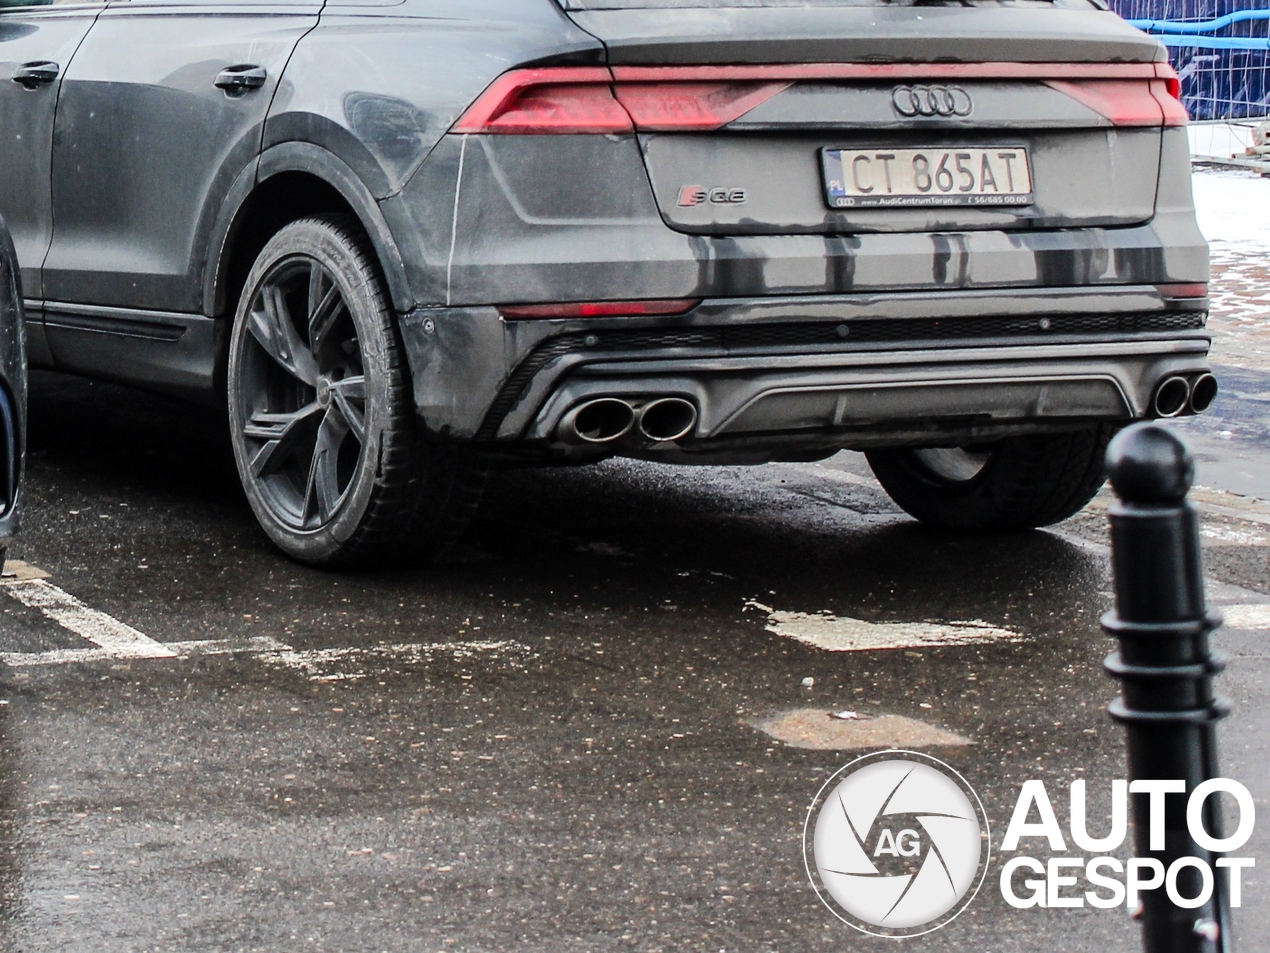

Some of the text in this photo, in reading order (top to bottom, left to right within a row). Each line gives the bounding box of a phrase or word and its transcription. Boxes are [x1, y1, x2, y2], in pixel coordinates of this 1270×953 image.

[830, 179, 844, 192] PL
[851, 153, 1017, 193] CT 865AT
